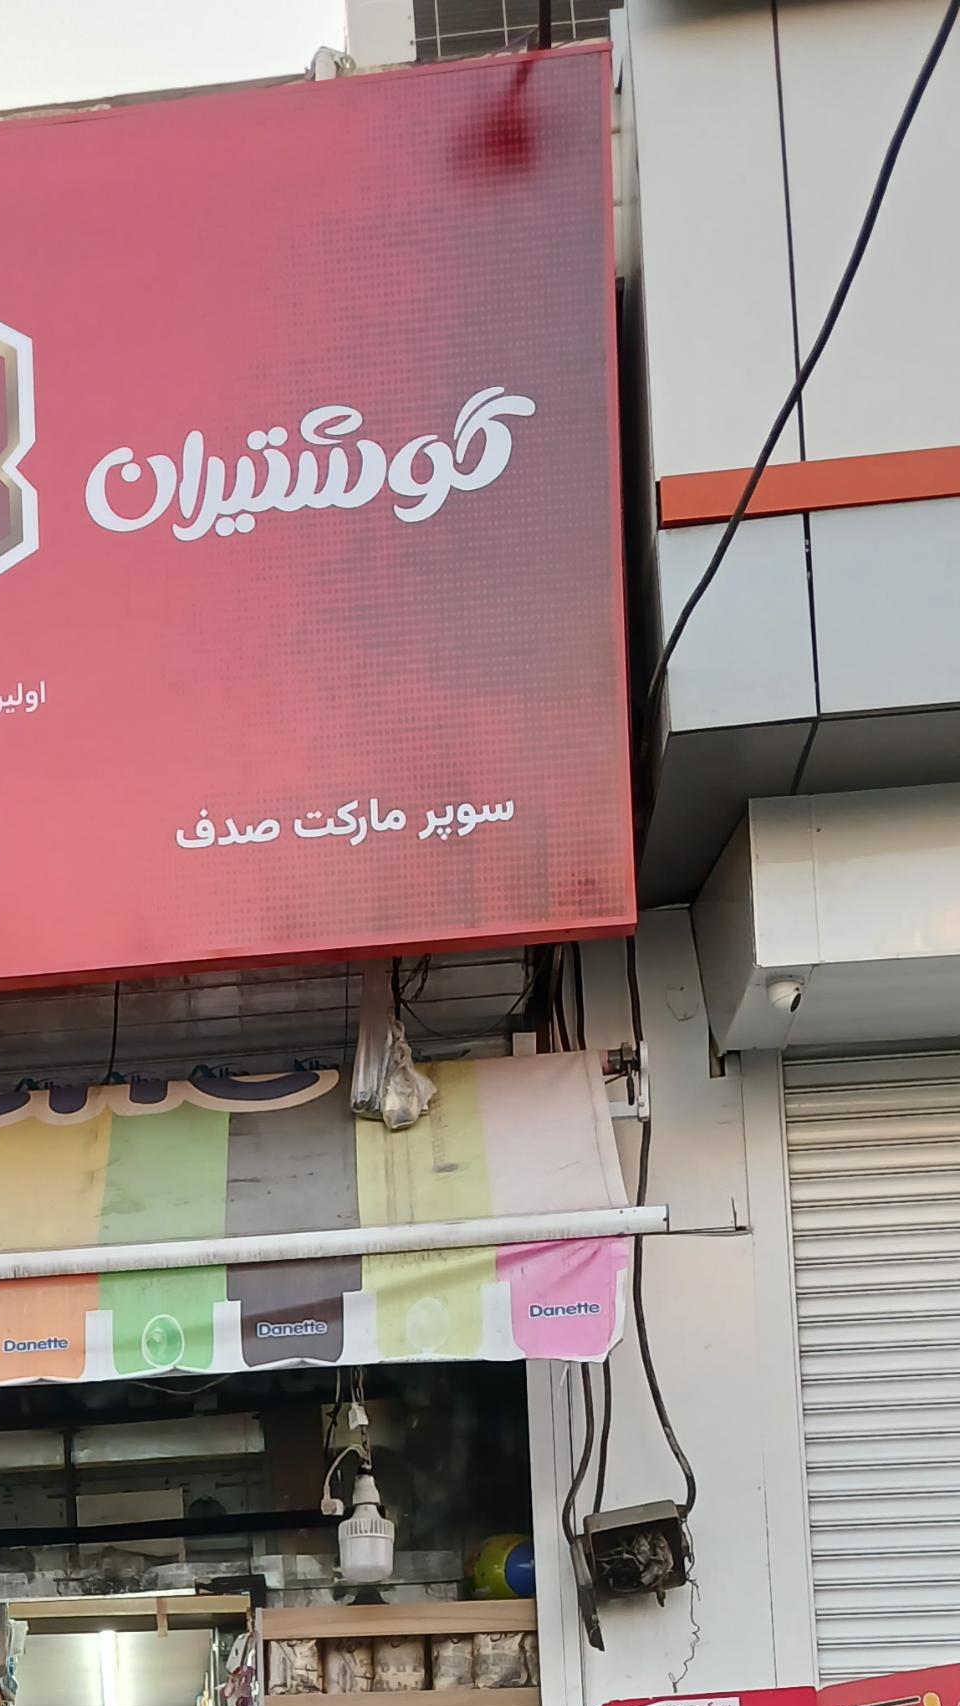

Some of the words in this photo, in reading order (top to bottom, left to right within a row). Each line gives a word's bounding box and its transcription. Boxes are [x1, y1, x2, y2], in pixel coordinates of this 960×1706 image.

[85, 386, 536, 541] گوشتیران
[174, 808, 281, 850] صدف
[293, 798, 407, 845] مارکت
[419, 797, 515, 841] سوپر
[256, 1318, 328, 1337] Danette
[528, 1300, 602, 1319] Danette
[3, 1335, 69, 1353] Danette
